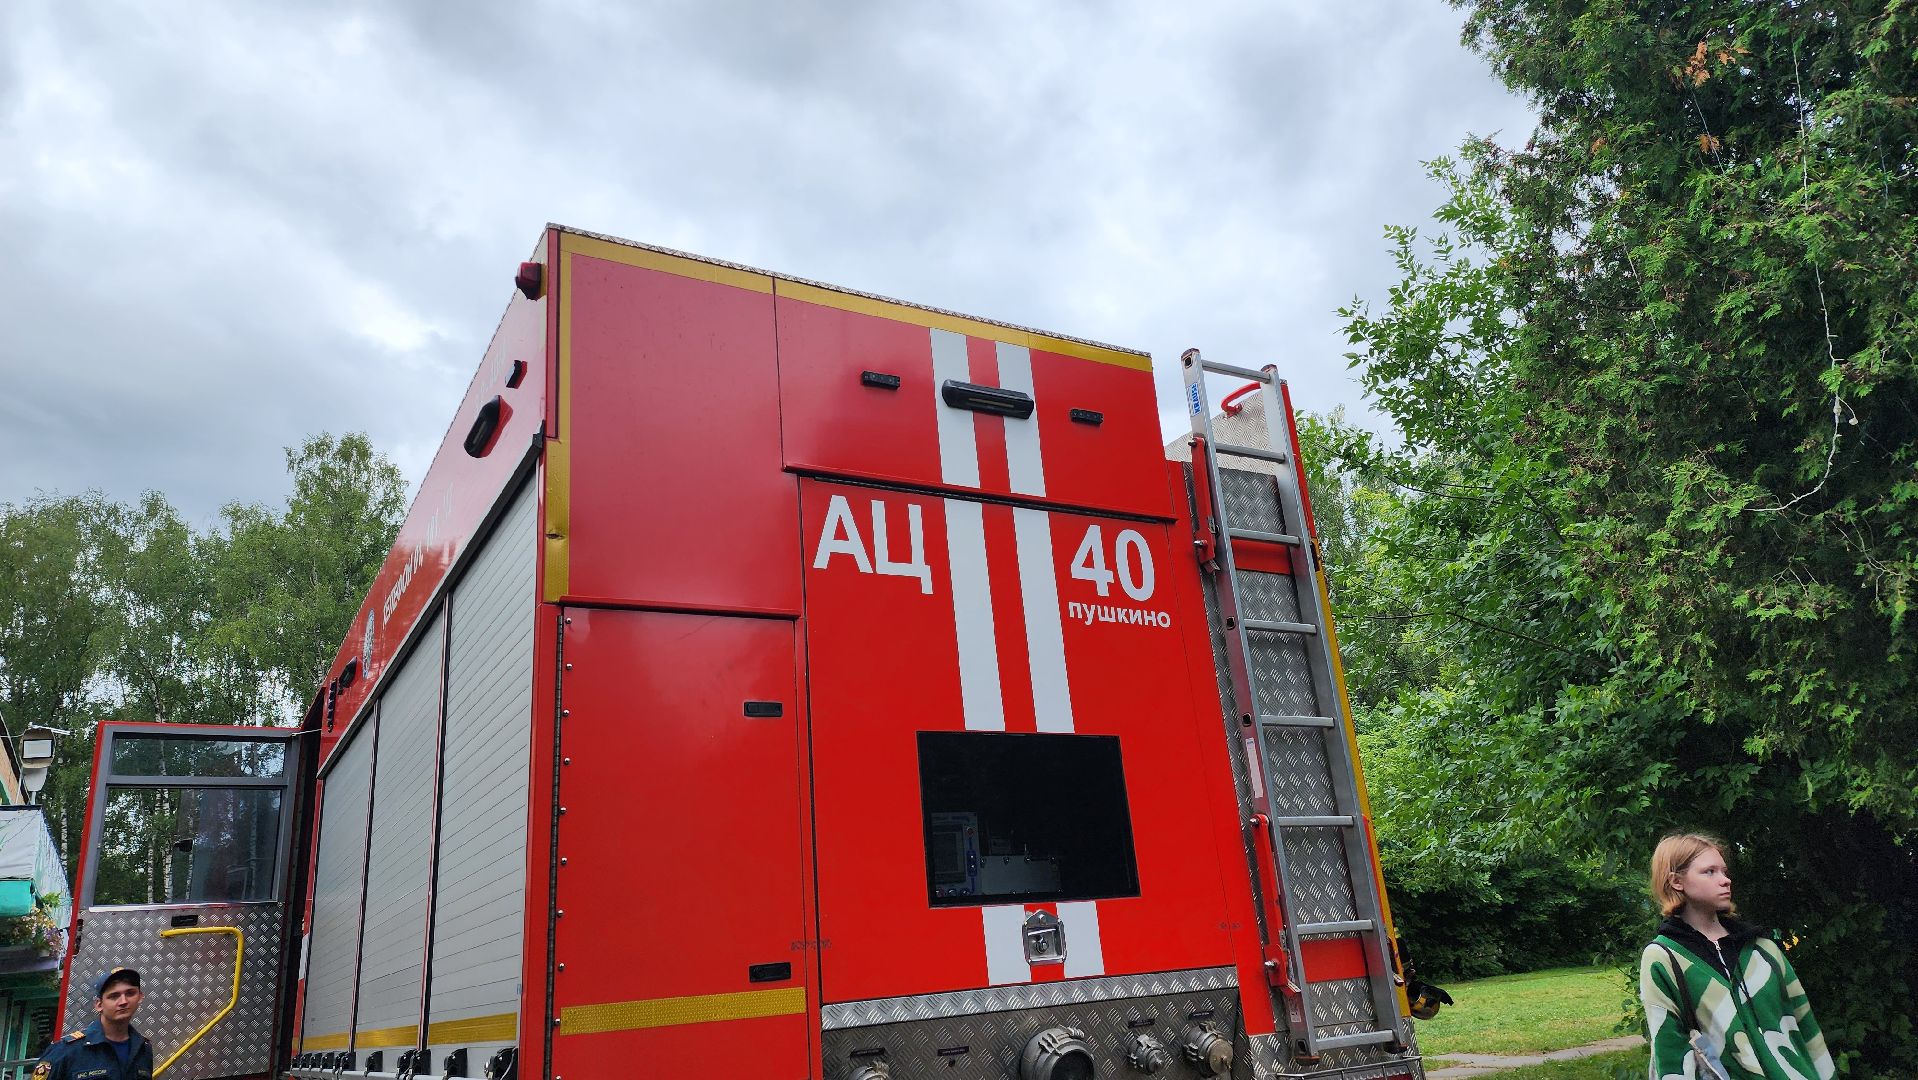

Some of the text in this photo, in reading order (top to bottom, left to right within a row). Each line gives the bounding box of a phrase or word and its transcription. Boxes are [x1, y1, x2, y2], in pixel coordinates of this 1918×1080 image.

[1191, 383, 1201, 414] KRAUSE
[812, 494, 1155, 602] АЦ 40
[1068, 601, 1171, 628] пушкино
